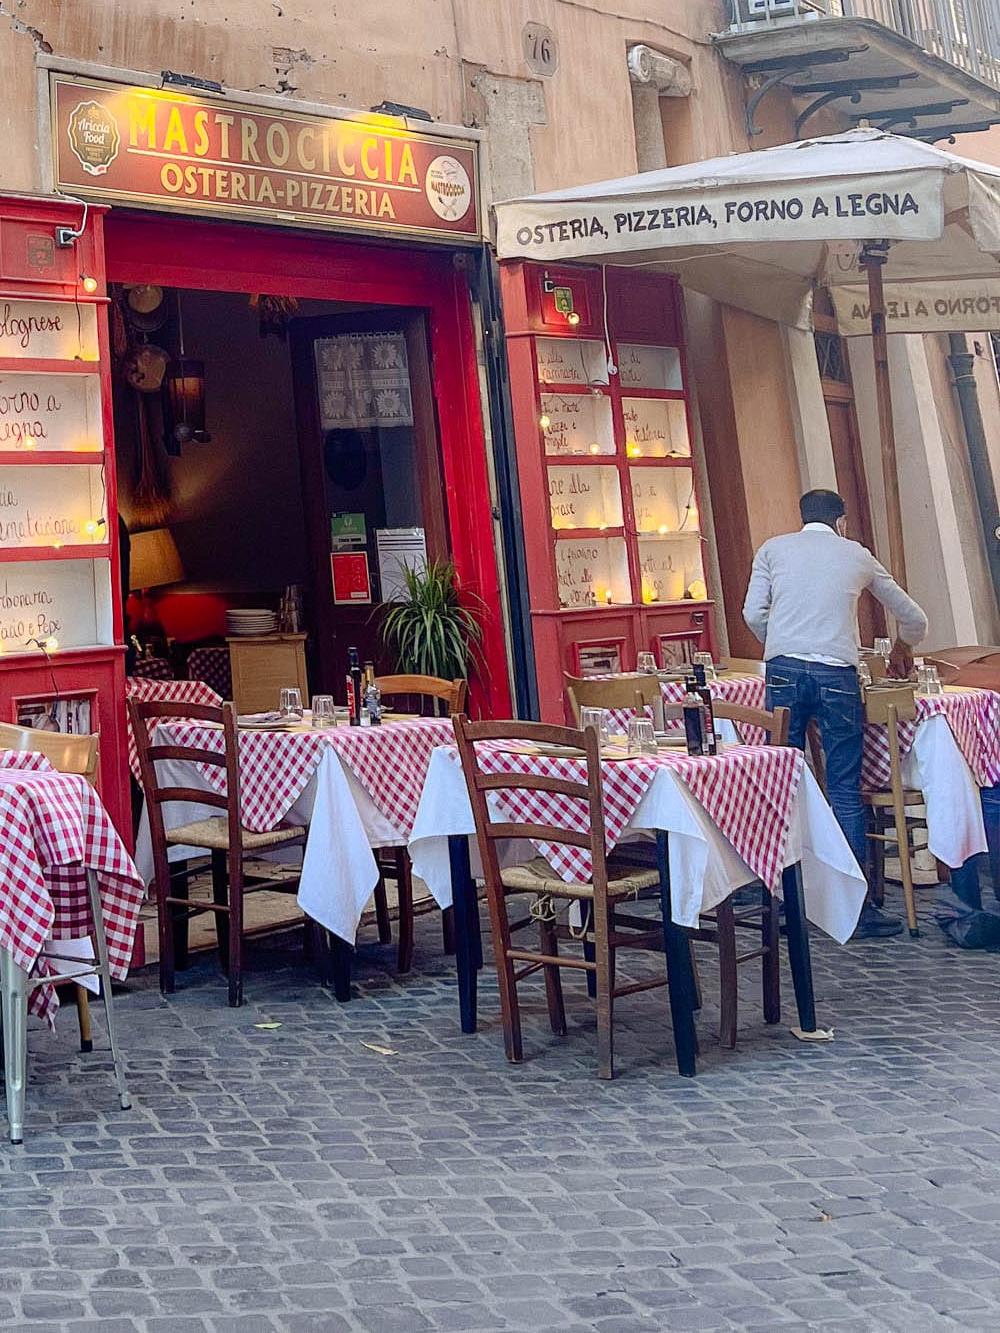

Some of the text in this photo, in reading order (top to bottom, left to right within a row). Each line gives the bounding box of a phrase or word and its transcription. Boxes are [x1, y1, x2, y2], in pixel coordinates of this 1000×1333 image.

[528, 34, 551, 64] 76
[78, 118, 110, 133] Ariccia
[84, 131, 105, 144] Food
[127, 98, 419, 185] MASTROCICCIA
[160, 162, 396, 218] OSTERIA-PIZZERIA
[516, 192, 920, 247] OSTERIA, PIZZERIA, FORNO A LEGNA
